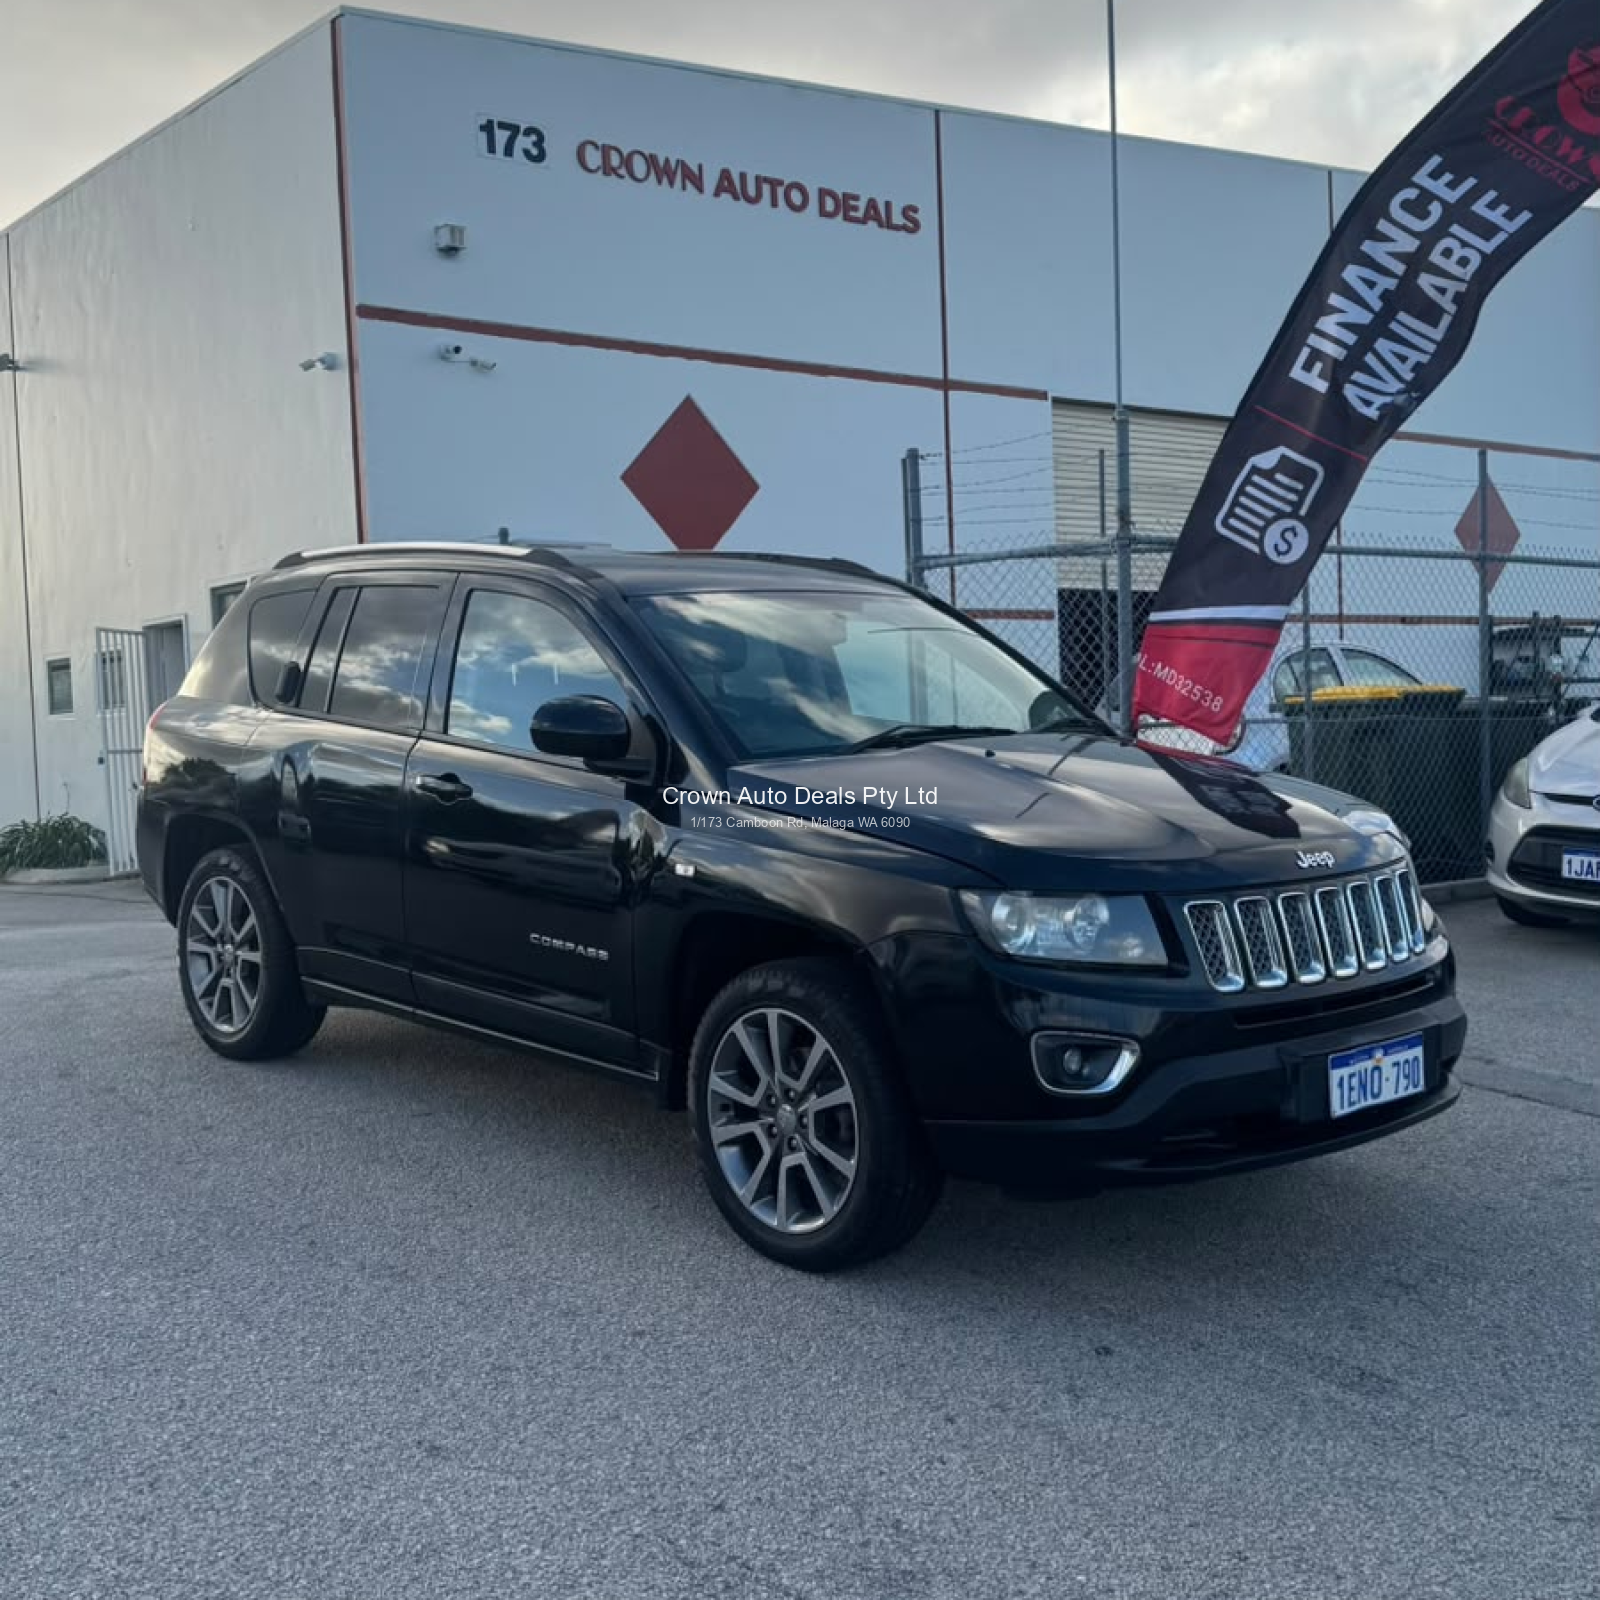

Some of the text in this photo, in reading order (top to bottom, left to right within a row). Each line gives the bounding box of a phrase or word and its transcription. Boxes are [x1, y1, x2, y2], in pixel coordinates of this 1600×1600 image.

[479, 118, 547, 164] 173
[1481, 128, 1580, 191] AUTO DEALS
[575, 139, 921, 234] CROWN AUTO DEALS
[1289, 154, 1479, 394] FINANCE
[1342, 189, 1534, 421] AVAILABLE
[1296, 850, 1335, 869] Jeep
[529, 932, 609, 961] COMPASS
